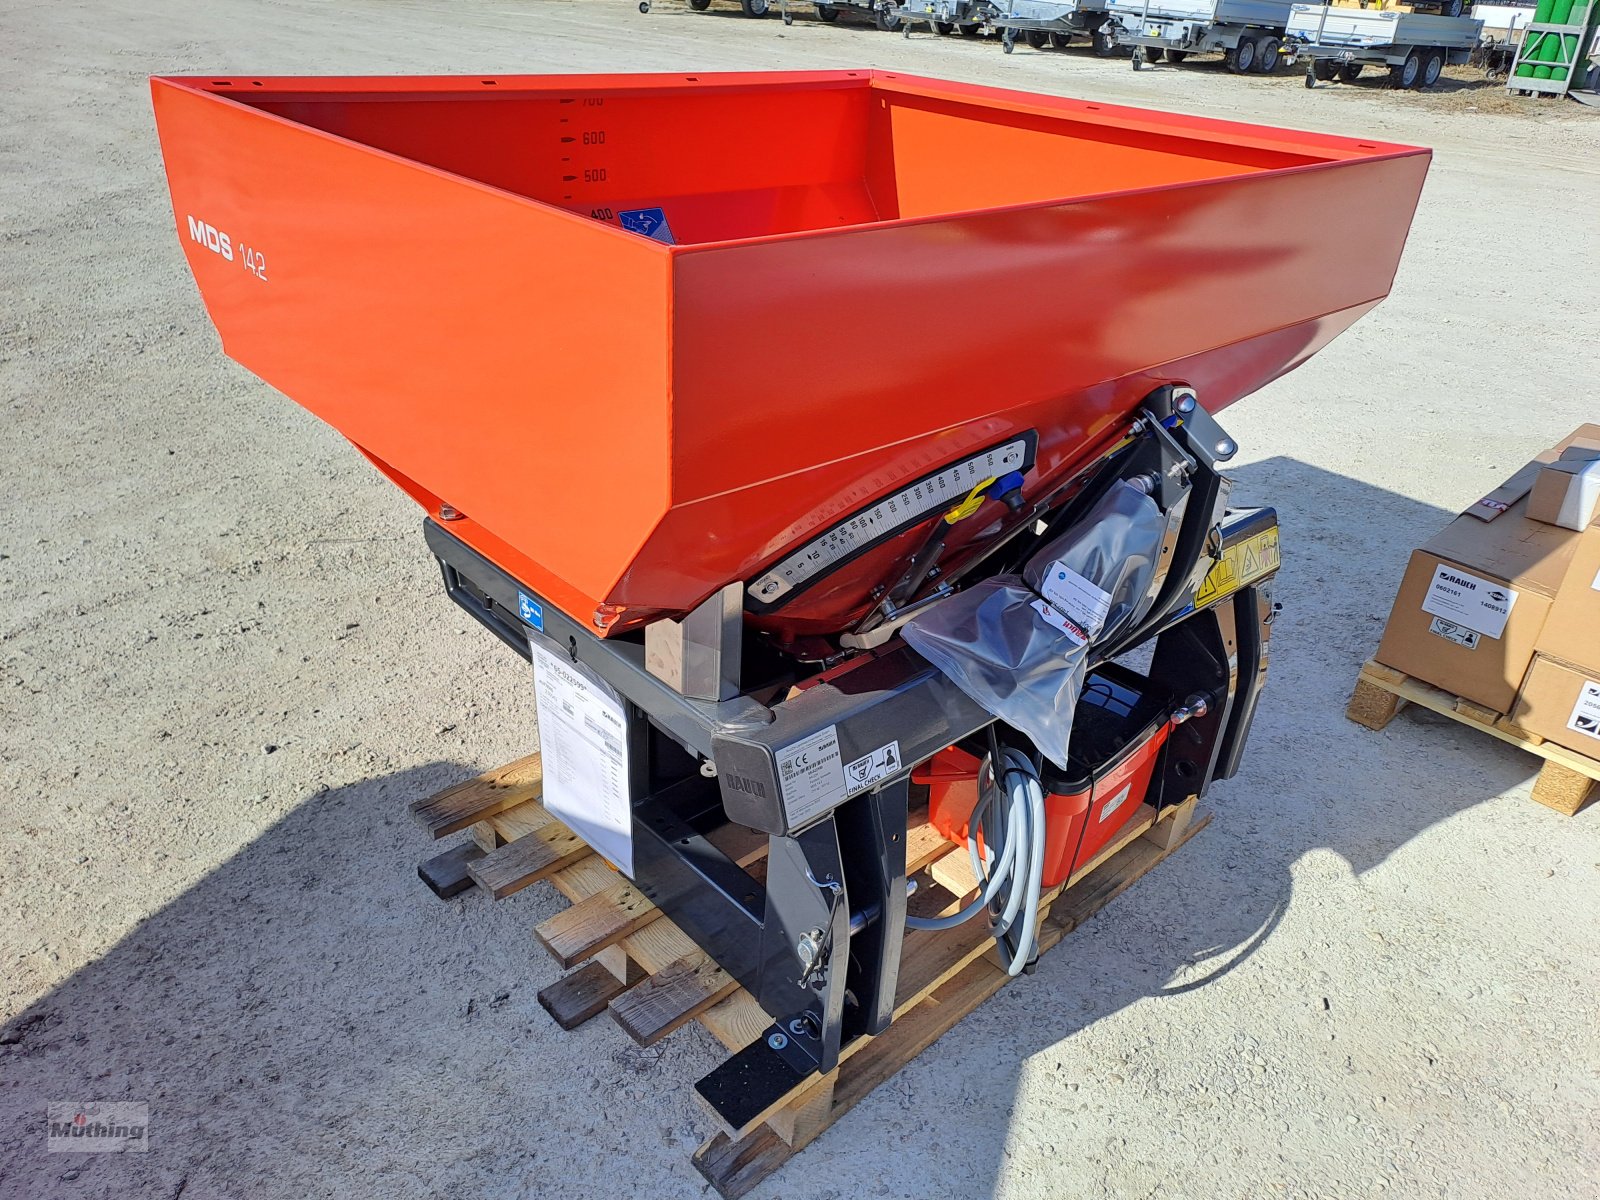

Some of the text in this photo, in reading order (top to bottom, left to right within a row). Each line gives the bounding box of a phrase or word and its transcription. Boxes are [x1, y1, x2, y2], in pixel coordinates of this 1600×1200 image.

[583, 131, 605, 145] 600
[584, 169, 607, 182] 500
[591, 208, 614, 221] 400
[187, 214, 268, 281] MDS 14.2
[811, 550, 820, 560] 10
[829, 532, 838, 542] 30
[839, 527, 848, 536] 50
[850, 520, 859, 530] 80
[858, 517, 868, 528] 100
[874, 508, 883, 520] 150
[888, 500, 897, 513] 200
[901, 493, 910, 506] 250
[913, 486, 922, 500] 300
[925, 481, 934, 494] 350
[938, 476, 946, 489] 400
[953, 469, 961, 482] 450
[968, 461, 976, 475] 500
[986, 454, 994, 466] 550
[1449, 575, 1477, 591] RAUCH
[726, 773, 766, 798] RAUCH
[848, 774, 881, 795] FINAL CHECK
